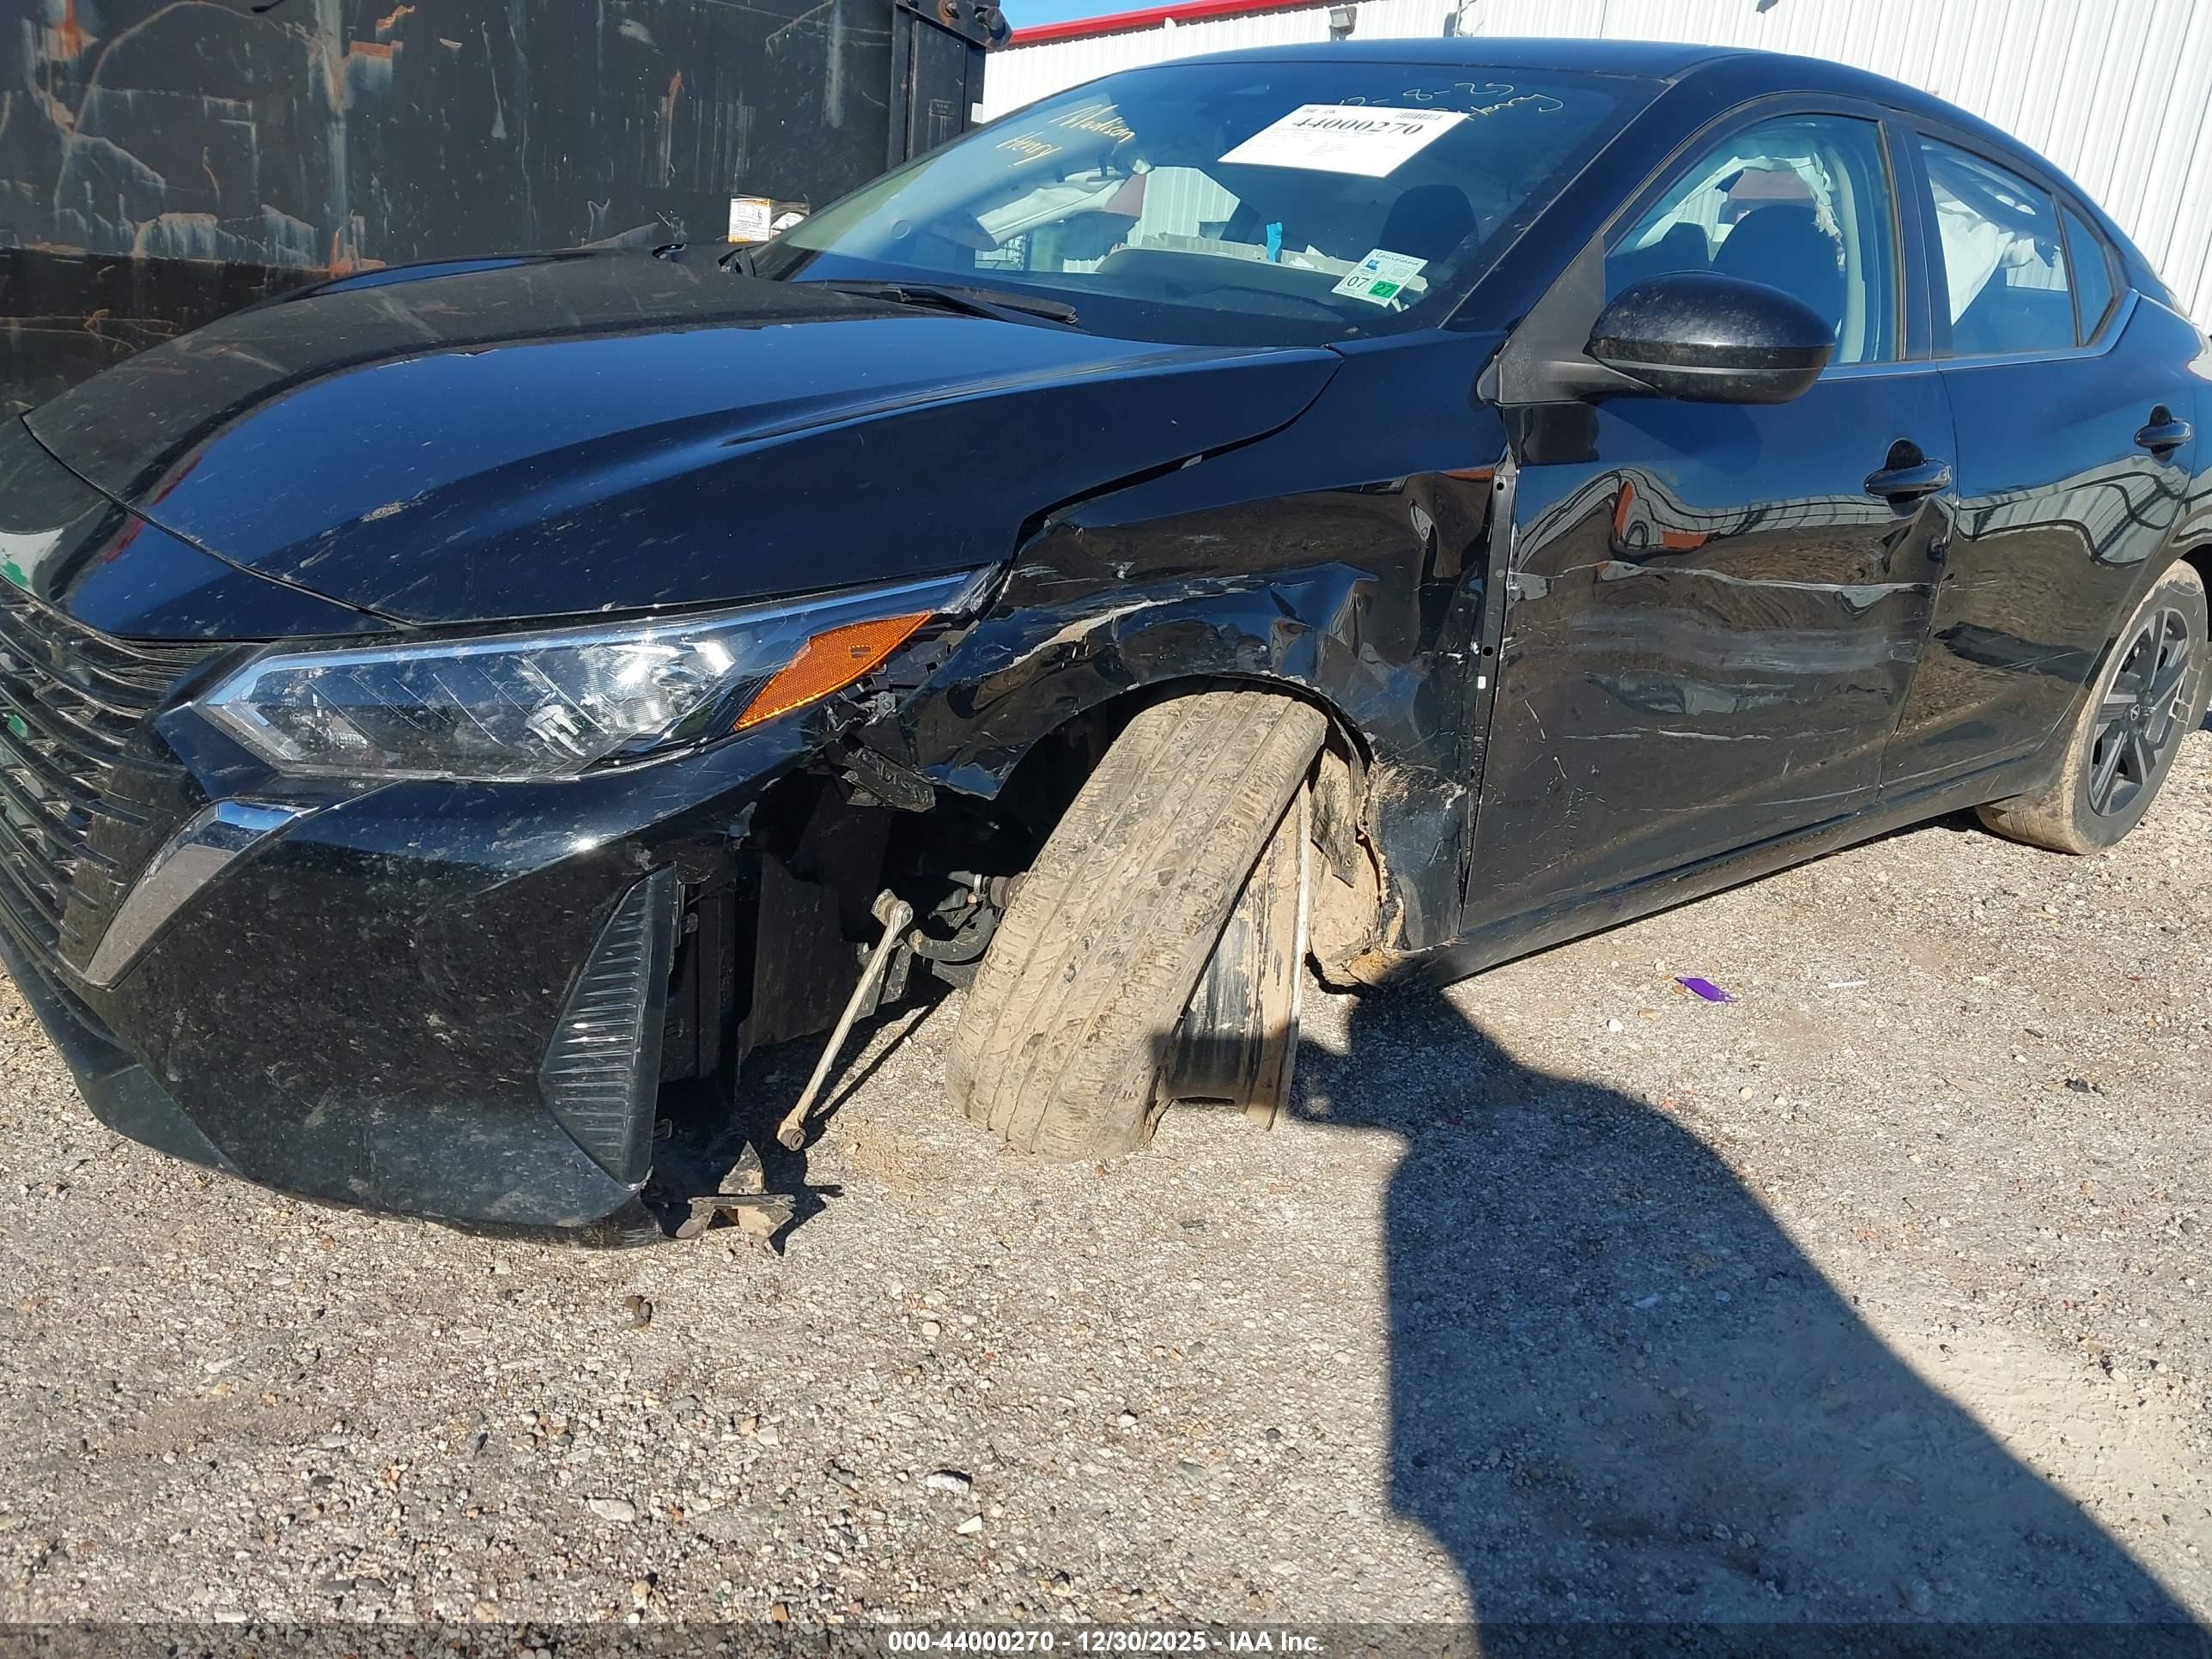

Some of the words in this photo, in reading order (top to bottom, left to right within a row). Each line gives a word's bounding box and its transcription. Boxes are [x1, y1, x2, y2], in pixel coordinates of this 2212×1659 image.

[1048, 104, 1136, 143] Madison
[1291, 117, 1425, 136] 44000270
[1346, 276, 1370, 289] 07
[1373, 283, 1397, 296] 27
